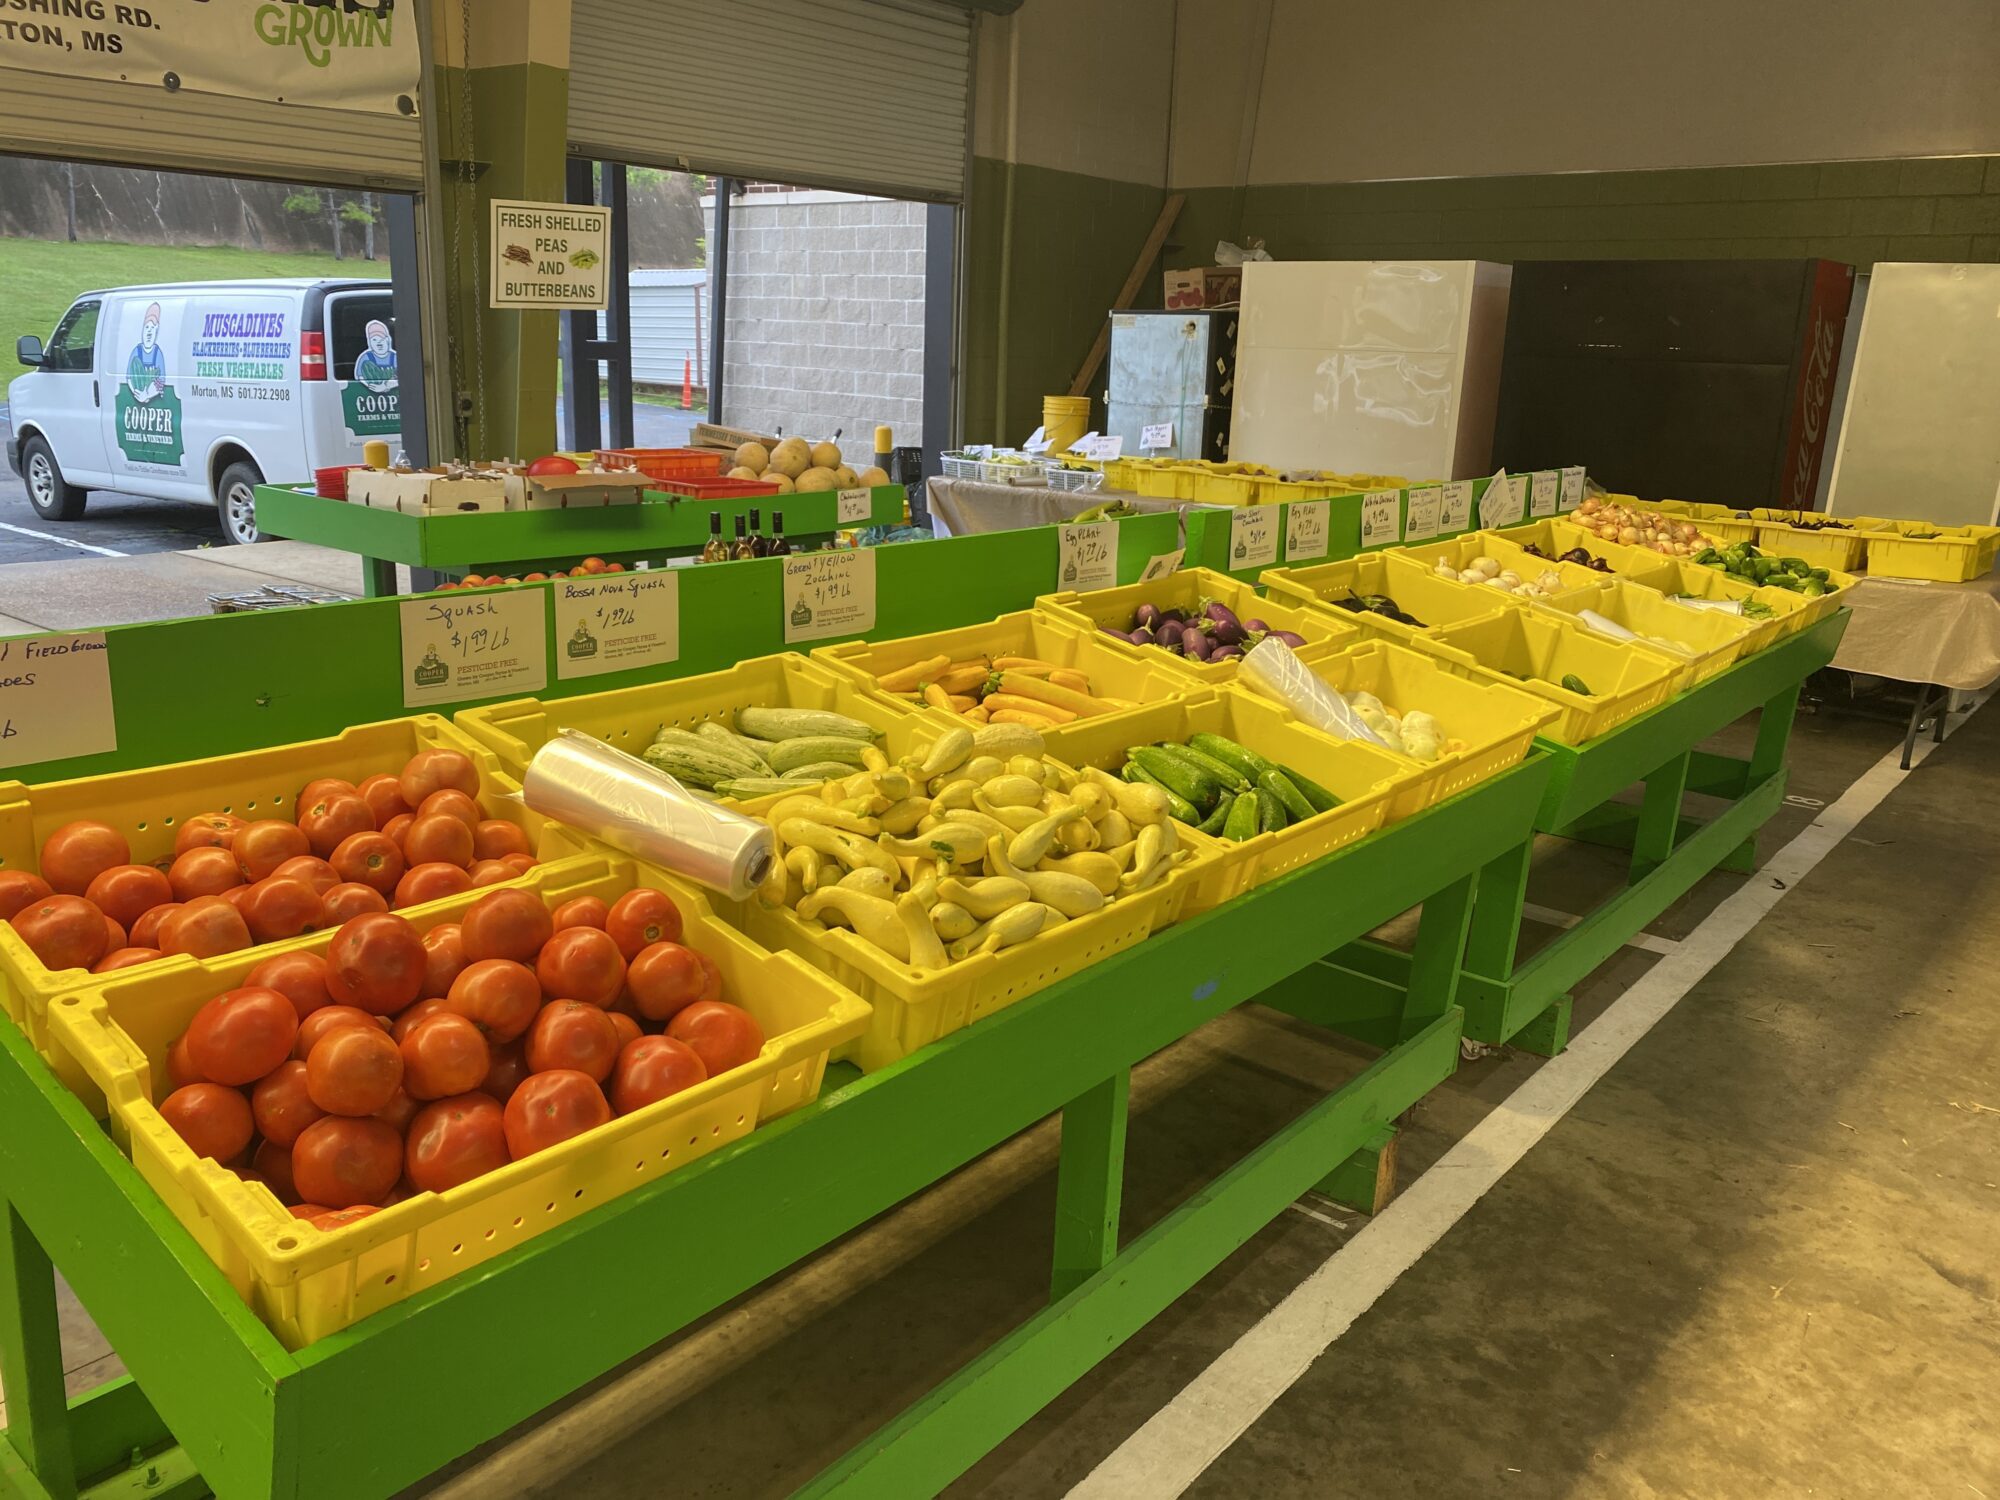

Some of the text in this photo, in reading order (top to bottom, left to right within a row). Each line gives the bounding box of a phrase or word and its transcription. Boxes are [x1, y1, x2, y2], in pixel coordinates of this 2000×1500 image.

[115, 7, 161, 30] RD.
[0, 20, 123, 54] TON, MS
[254, 4, 392, 67] GROWN
[501, 213, 602, 232] FRESH SHELLED
[535, 238, 568, 253] PEAS
[537, 261, 565, 275] AND
[505, 282, 596, 298] BUTTERBEANS
[202, 313, 285, 338] MUSCADINES
[197, 362, 284, 380] FRESH VEGETABLES
[221, 385, 234, 398] MS
[238, 387, 290, 401] 601.732.2908
[356, 395, 398, 412] COOP
[124, 406, 172, 433] COOPER
[640, 633, 657, 641] FREE
[457, 658, 518, 674] PESTICIDE FREE
